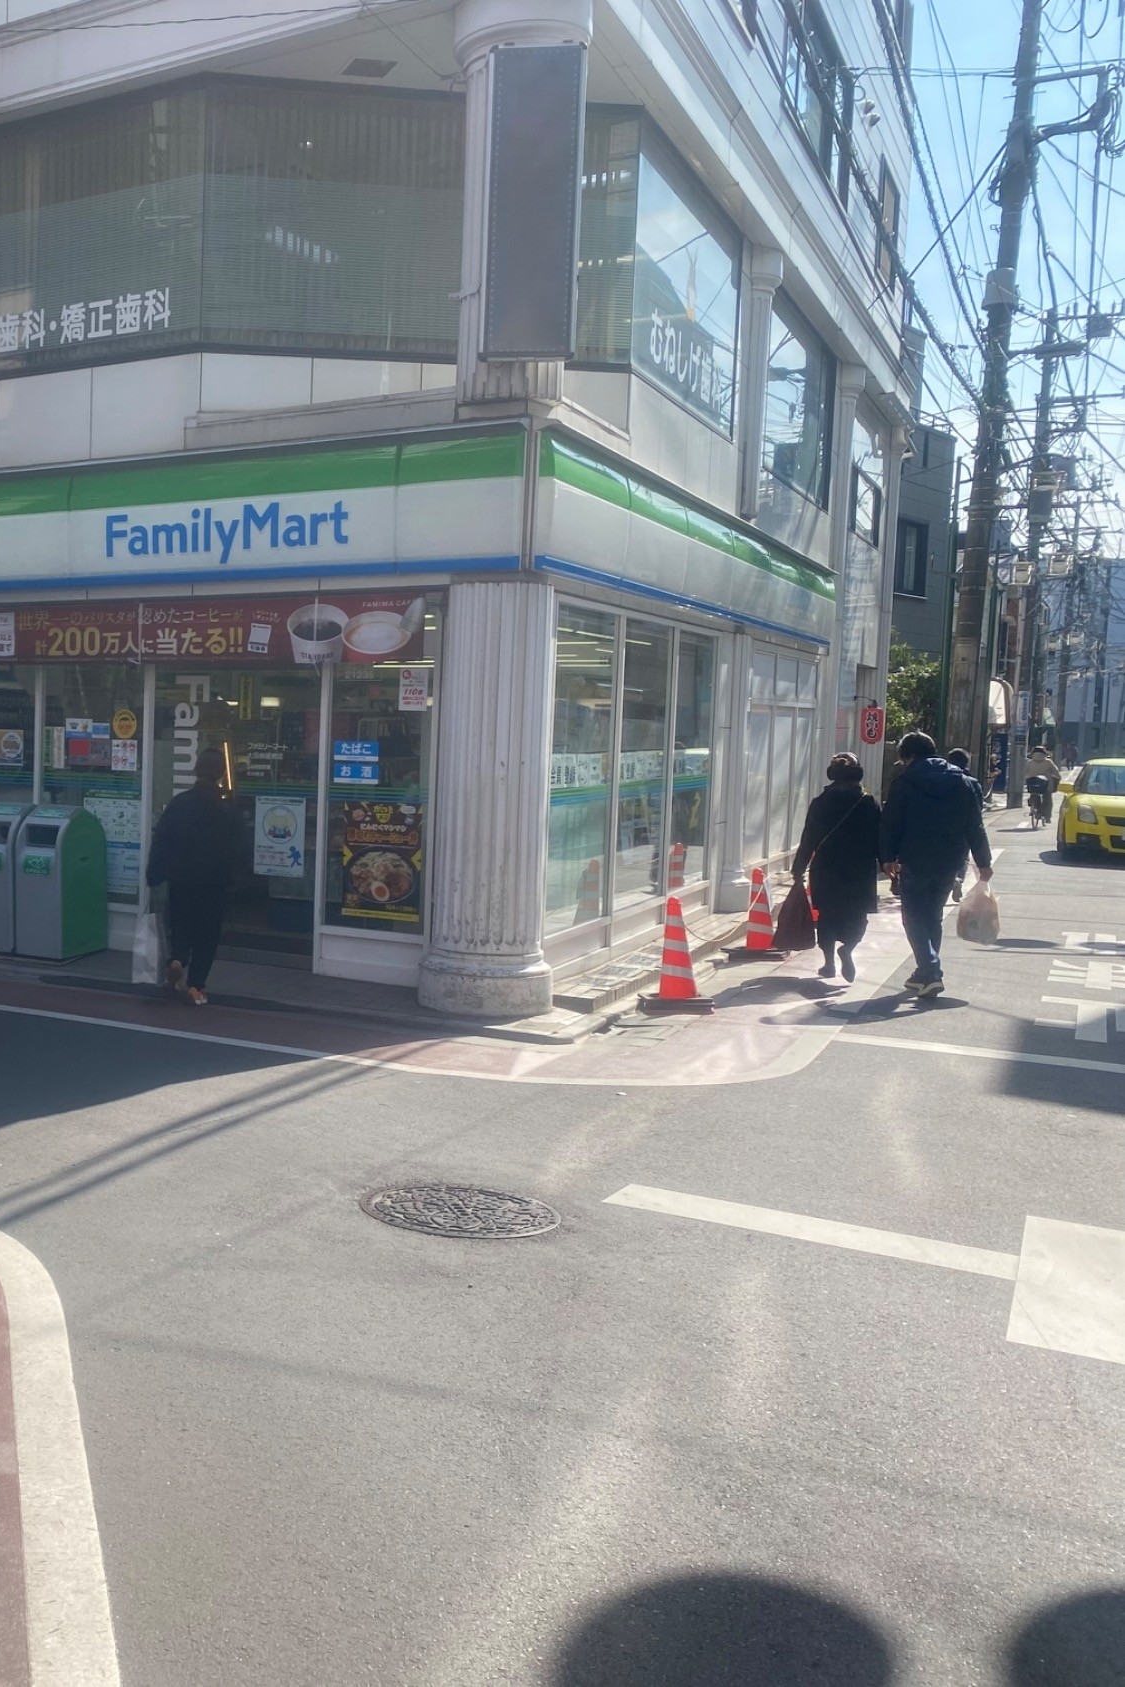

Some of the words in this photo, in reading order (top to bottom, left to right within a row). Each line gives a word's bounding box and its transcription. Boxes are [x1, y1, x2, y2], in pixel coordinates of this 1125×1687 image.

[650, 308, 721, 413] むねしげ歯科
[106, 500, 349, 564] FamilyMart
[341, 743, 372, 755] たばこ
